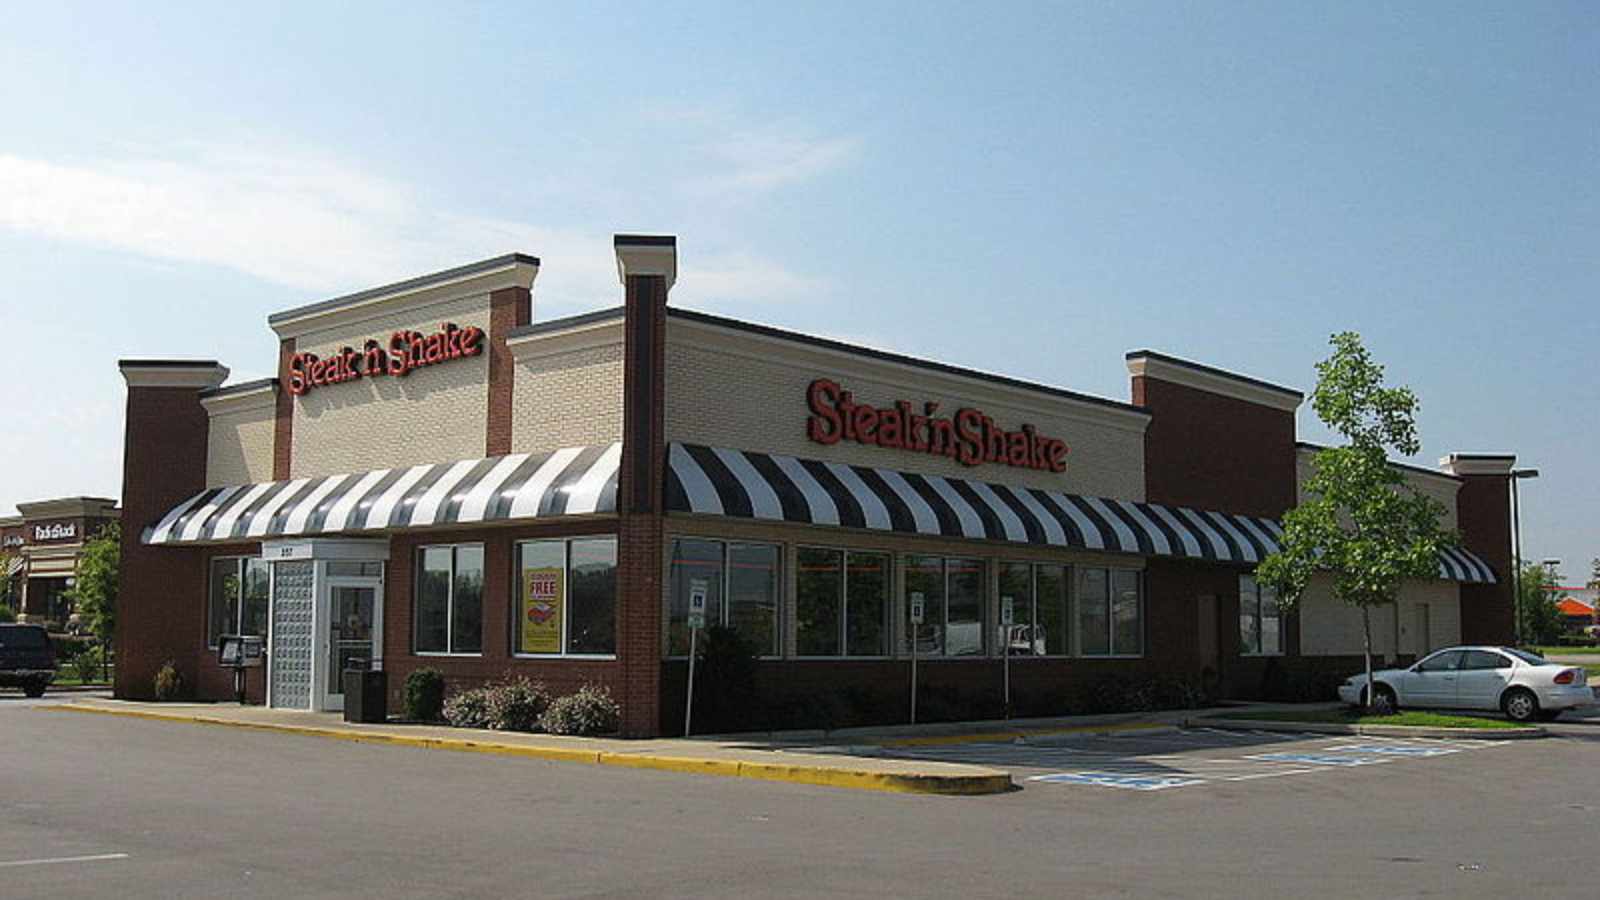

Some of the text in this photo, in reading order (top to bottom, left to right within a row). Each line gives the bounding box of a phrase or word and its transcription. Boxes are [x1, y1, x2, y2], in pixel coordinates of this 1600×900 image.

[288, 345, 362, 396] Steak
[388, 322, 485, 377] Shake
[807, 378, 927, 452] Steak
[954, 408, 1068, 473] Shake
[529, 581, 556, 594] FREE
